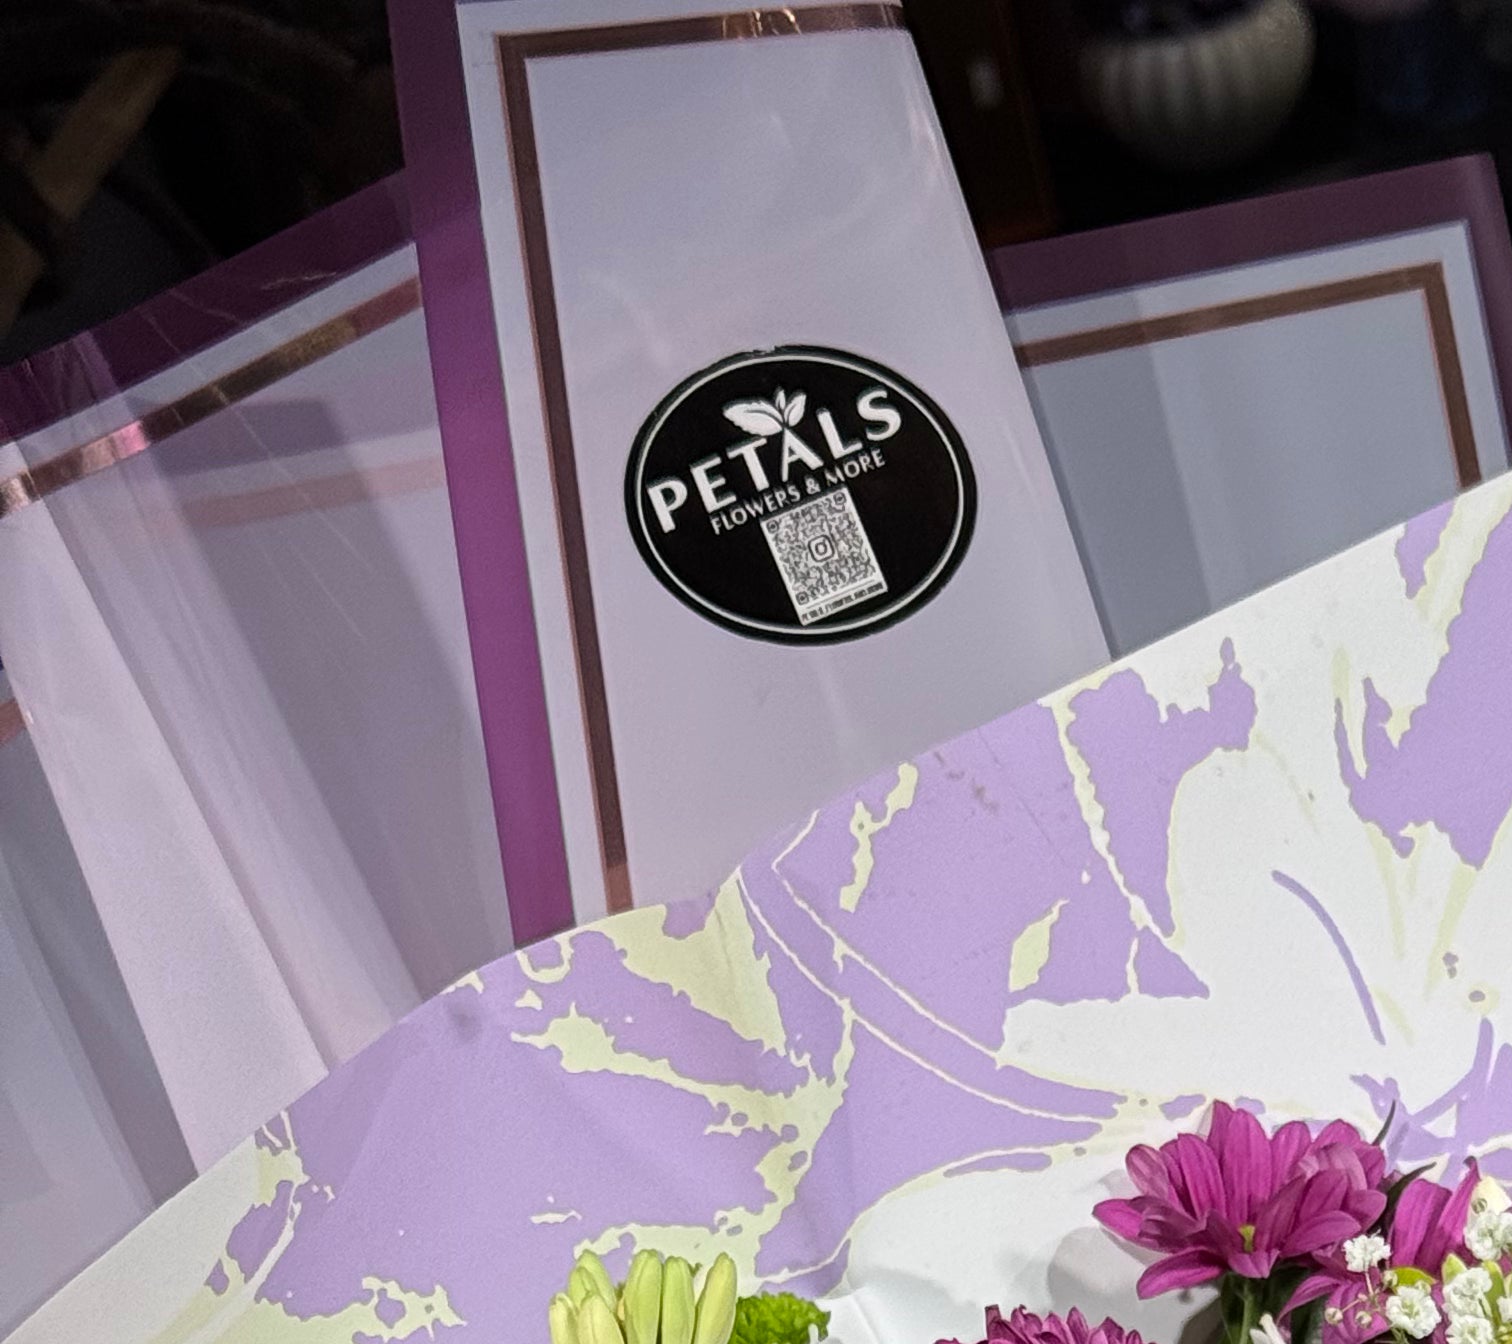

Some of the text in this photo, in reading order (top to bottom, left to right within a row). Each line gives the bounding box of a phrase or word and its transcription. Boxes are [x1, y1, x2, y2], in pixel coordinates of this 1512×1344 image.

[648, 389, 901, 534] PETALS
[710, 448, 886, 535] FLOWERS & MORE
